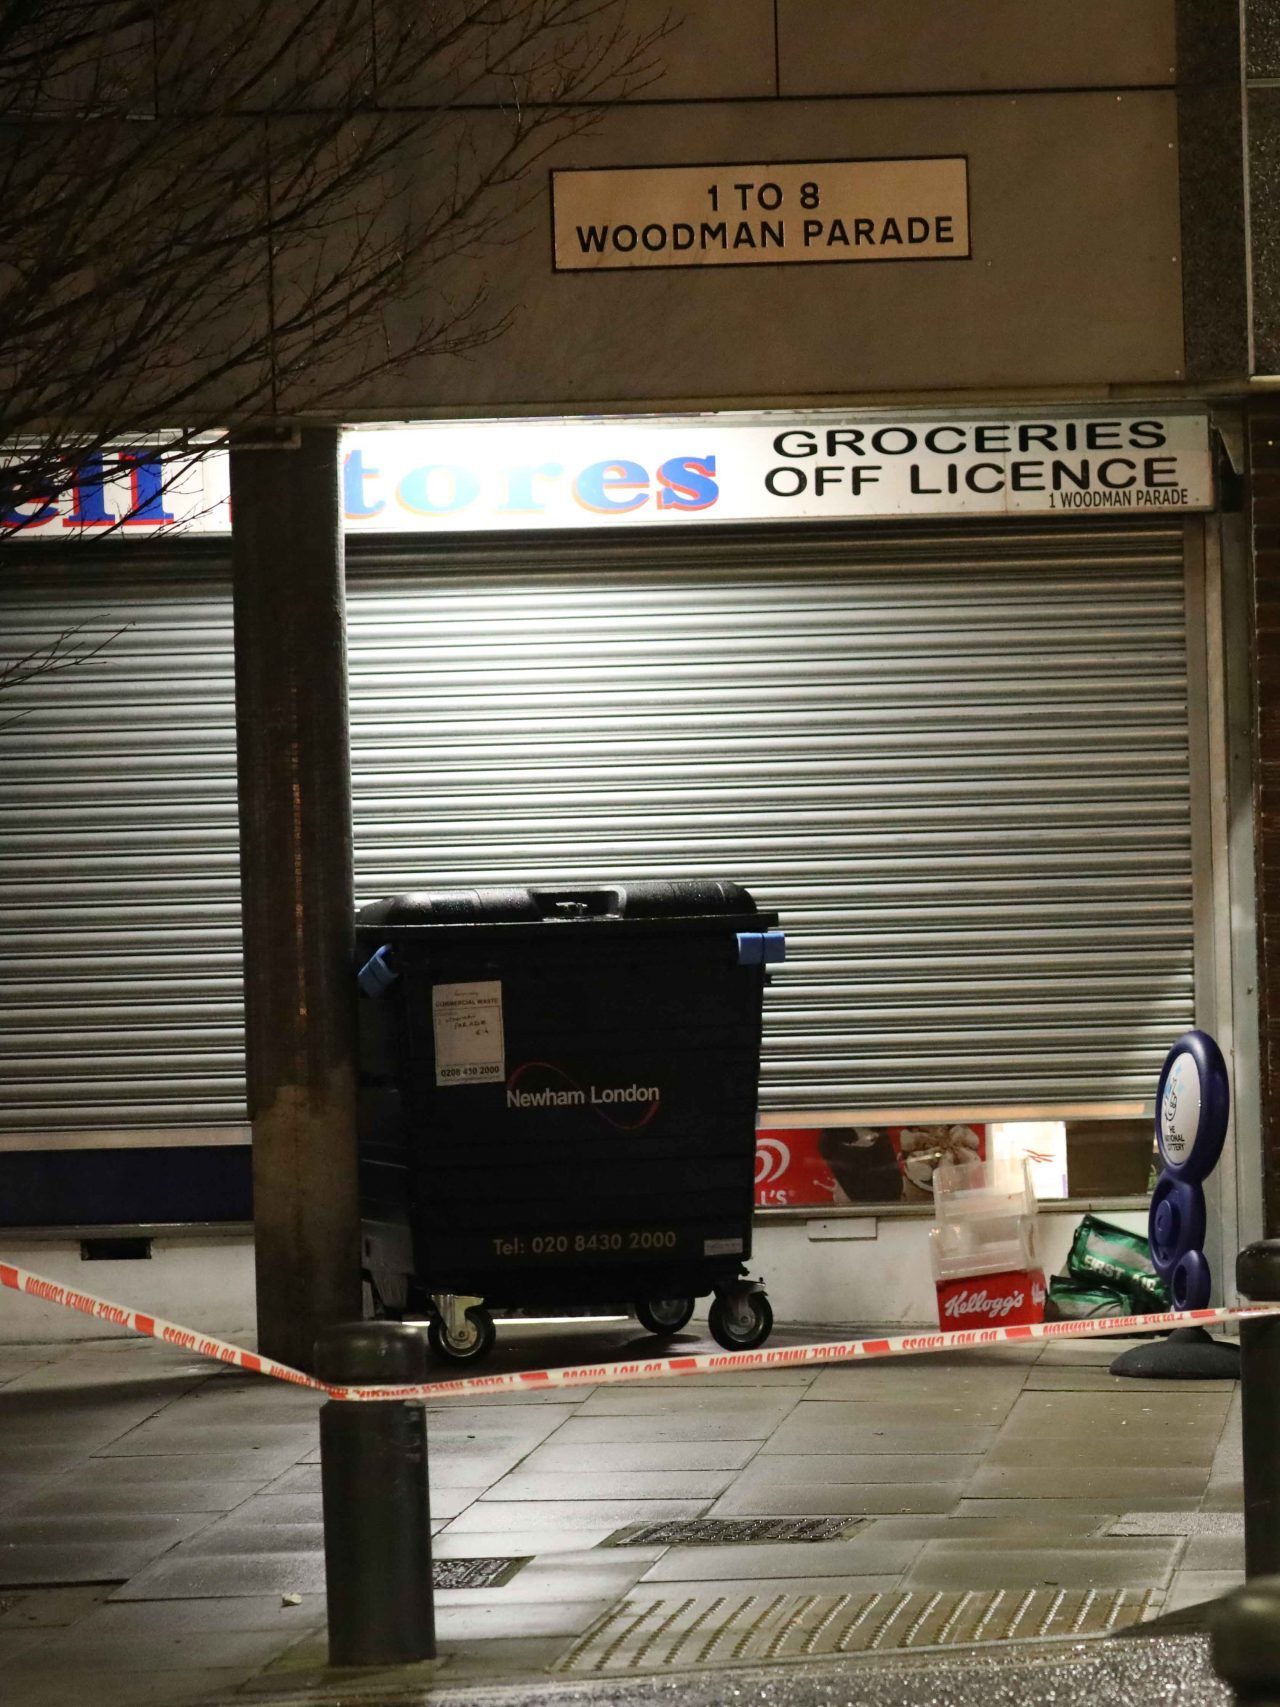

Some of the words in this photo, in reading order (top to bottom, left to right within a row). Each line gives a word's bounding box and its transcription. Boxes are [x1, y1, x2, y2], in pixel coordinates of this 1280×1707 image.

[707, 185, 719, 212] 1
[733, 182, 783, 211] TO
[799, 181, 821, 210] 8
[575, 220, 786, 254] WOODMAN
[803, 215, 955, 248] PARADE
[772, 420, 1168, 459] GROCERIES
[343, 448, 720, 521] tores
[764, 464, 883, 498] OFF
[909, 456, 1181, 495] LICENCE
[1048, 492, 1056, 509] 1
[1059, 489, 1133, 508] WOODMAN
[1135, 487, 1189, 507] PARADE
[506, 1087, 585, 1109] Newham
[590, 1084, 660, 1104] London
[493, 1238, 526, 1256] Tel:
[531, 1236, 569, 1254] 020
[574, 1233, 623, 1252] 8430
[628, 1231, 677, 1250] 2000
[944, 1289, 1025, 1318] Kellogg's
